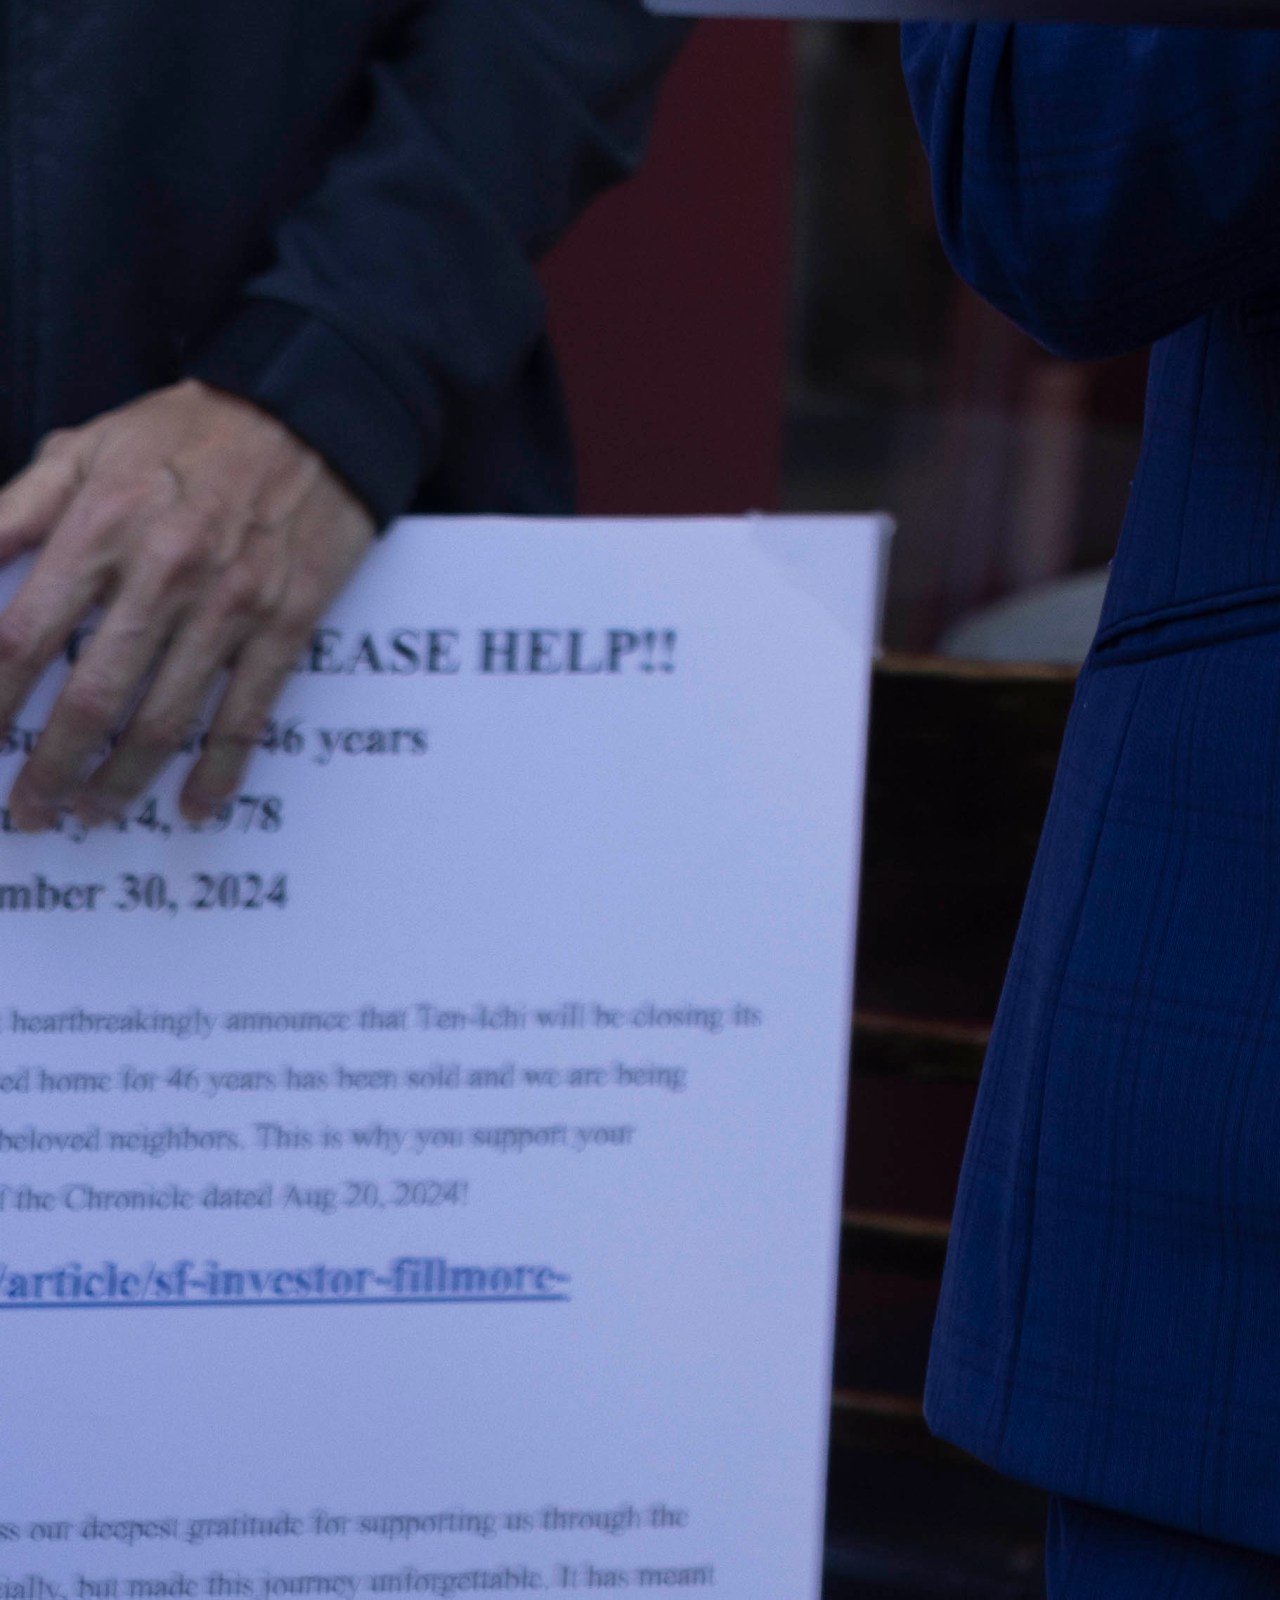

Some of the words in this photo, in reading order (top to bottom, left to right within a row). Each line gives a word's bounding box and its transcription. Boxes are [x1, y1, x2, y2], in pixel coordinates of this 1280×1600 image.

[298, 628, 461, 674] EASE
[479, 628, 678, 675] HELP!!
[320, 724, 429, 766] years
[193, 795, 283, 834] 978
[117, 873, 179, 919] 30,
[194, 872, 289, 911] 2024
[11, 1006, 216, 1040] heartbreakingly
[225, 1010, 350, 1032] announce
[360, 1004, 406, 1031] that
[417, 1002, 527, 1030] Ten-Ichi
[536, 1001, 586, 1028] will
[595, 1003, 626, 1028] be
[632, 1003, 725, 1035] closing
[734, 1002, 762, 1028] its
[41, 1065, 112, 1092] home
[121, 1064, 156, 1092] for
[165, 1066, 201, 1091] 46
[208, 1069, 277, 1099] years
[287, 1064, 328, 1091] has
[337, 1063, 398, 1091] been
[407, 1062, 461, 1090] sold
[469, 1062, 515, 1089] and
[524, 1067, 557, 1088] we
[569, 1066, 608, 1088] are
[617, 1061, 688, 1093] being
[110, 1125, 244, 1158] neighbors.
[254, 1121, 313, 1150] This
[322, 1124, 343, 1149] is
[353, 1123, 407, 1155] why
[415, 1126, 464, 1155] you
[473, 1123, 568, 1153] support
[576, 1125, 636, 1152] your
[16, 1185, 54, 1211] the
[61, 1183, 194, 1211] Chronicle
[203, 1182, 273, 1209] dated
[283, 1183, 338, 1215] Aug
[344, 1179, 388, 1210] 20,
[395, 1178, 469, 1208] 2024!
[28, 1520, 72, 1542] our
[80, 1514, 179, 1546] deepest
[187, 1511, 304, 1545] gratitude
[313, 1509, 352, 1536] for
[360, 1506, 496, 1540] supporting
[506, 1511, 536, 1532] us
[544, 1504, 641, 1536] through
[650, 1502, 688, 1529] the
[78, 1573, 120, 1600] but
[128, 1571, 198, 1598] made
[206, 1569, 252, 1596] this
[260, 1572, 360, 1600] journey
[369, 1565, 549, 1599] unforgettable.
[559, 1563, 578, 1589] It
[588, 1563, 632, 1588] has
[640, 1562, 715, 1587] meant
